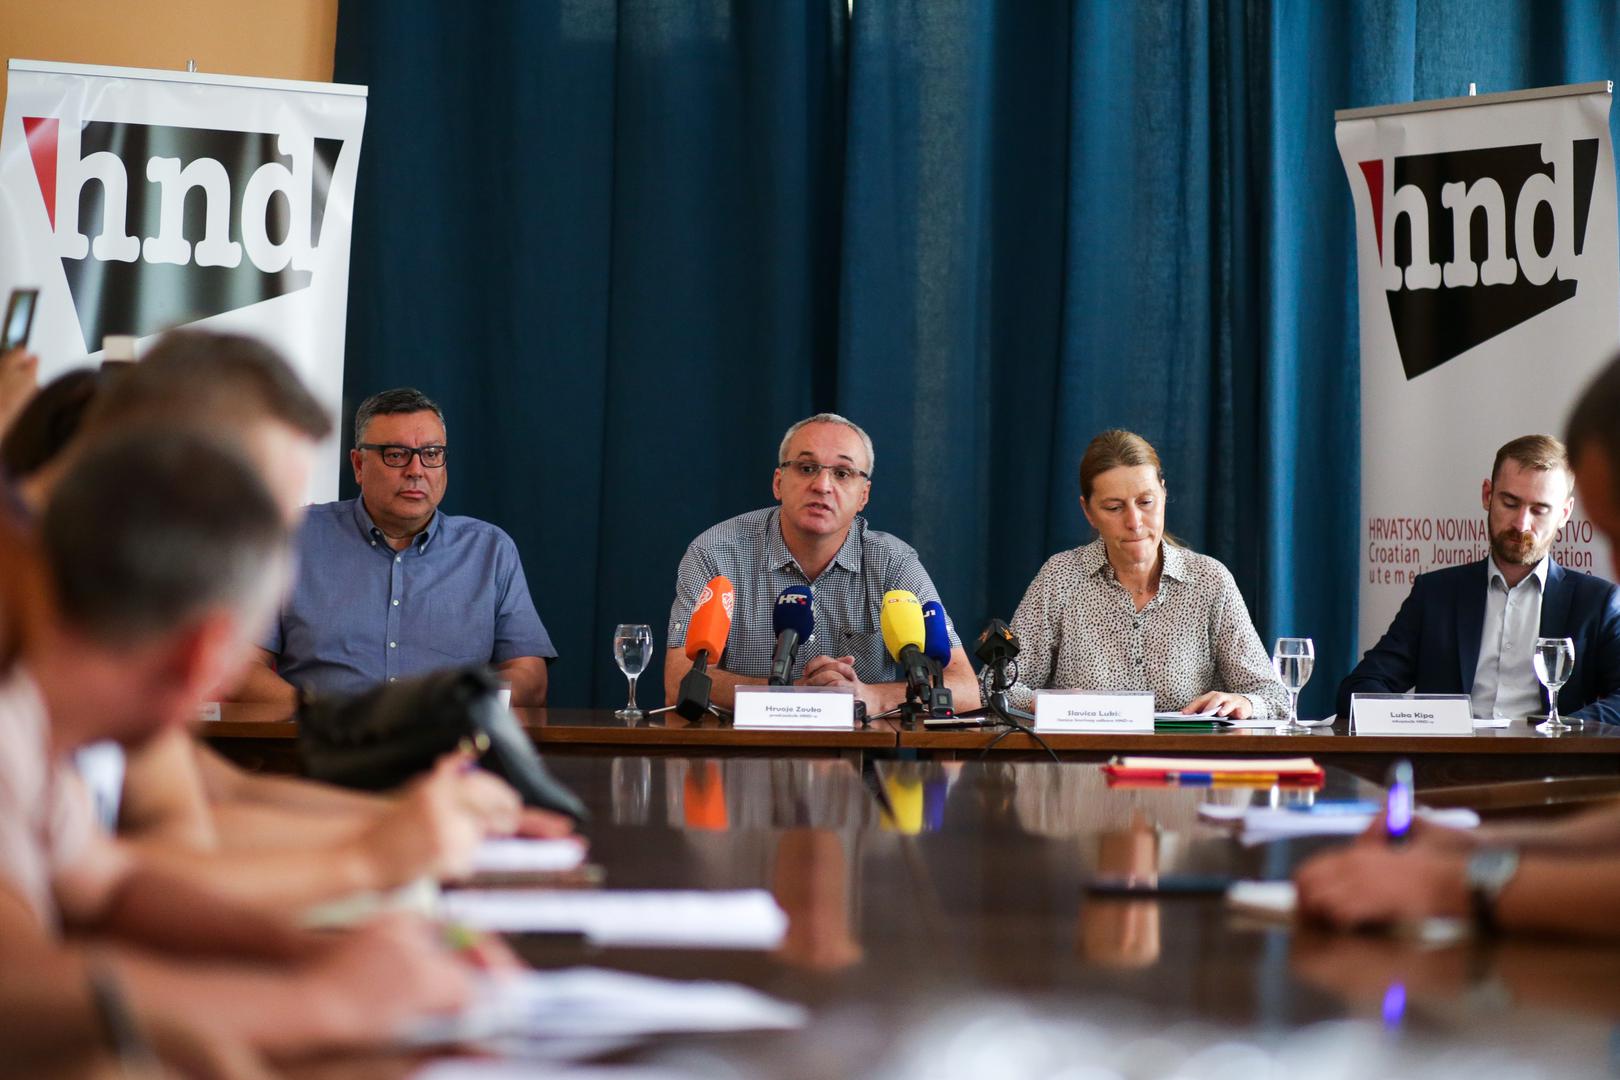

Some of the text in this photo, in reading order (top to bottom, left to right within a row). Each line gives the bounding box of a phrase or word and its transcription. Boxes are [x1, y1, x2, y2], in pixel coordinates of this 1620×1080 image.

[54, 118, 317, 274] hnd
[1380, 142, 1577, 292] hnd
[1369, 518, 1432, 541] HRVATSKO
[1436, 518, 1489, 541] NOVINA
[1368, 542, 1420, 564] Croatian
[1552, 546, 1593, 567] iation
[778, 594, 807, 605] HRT
